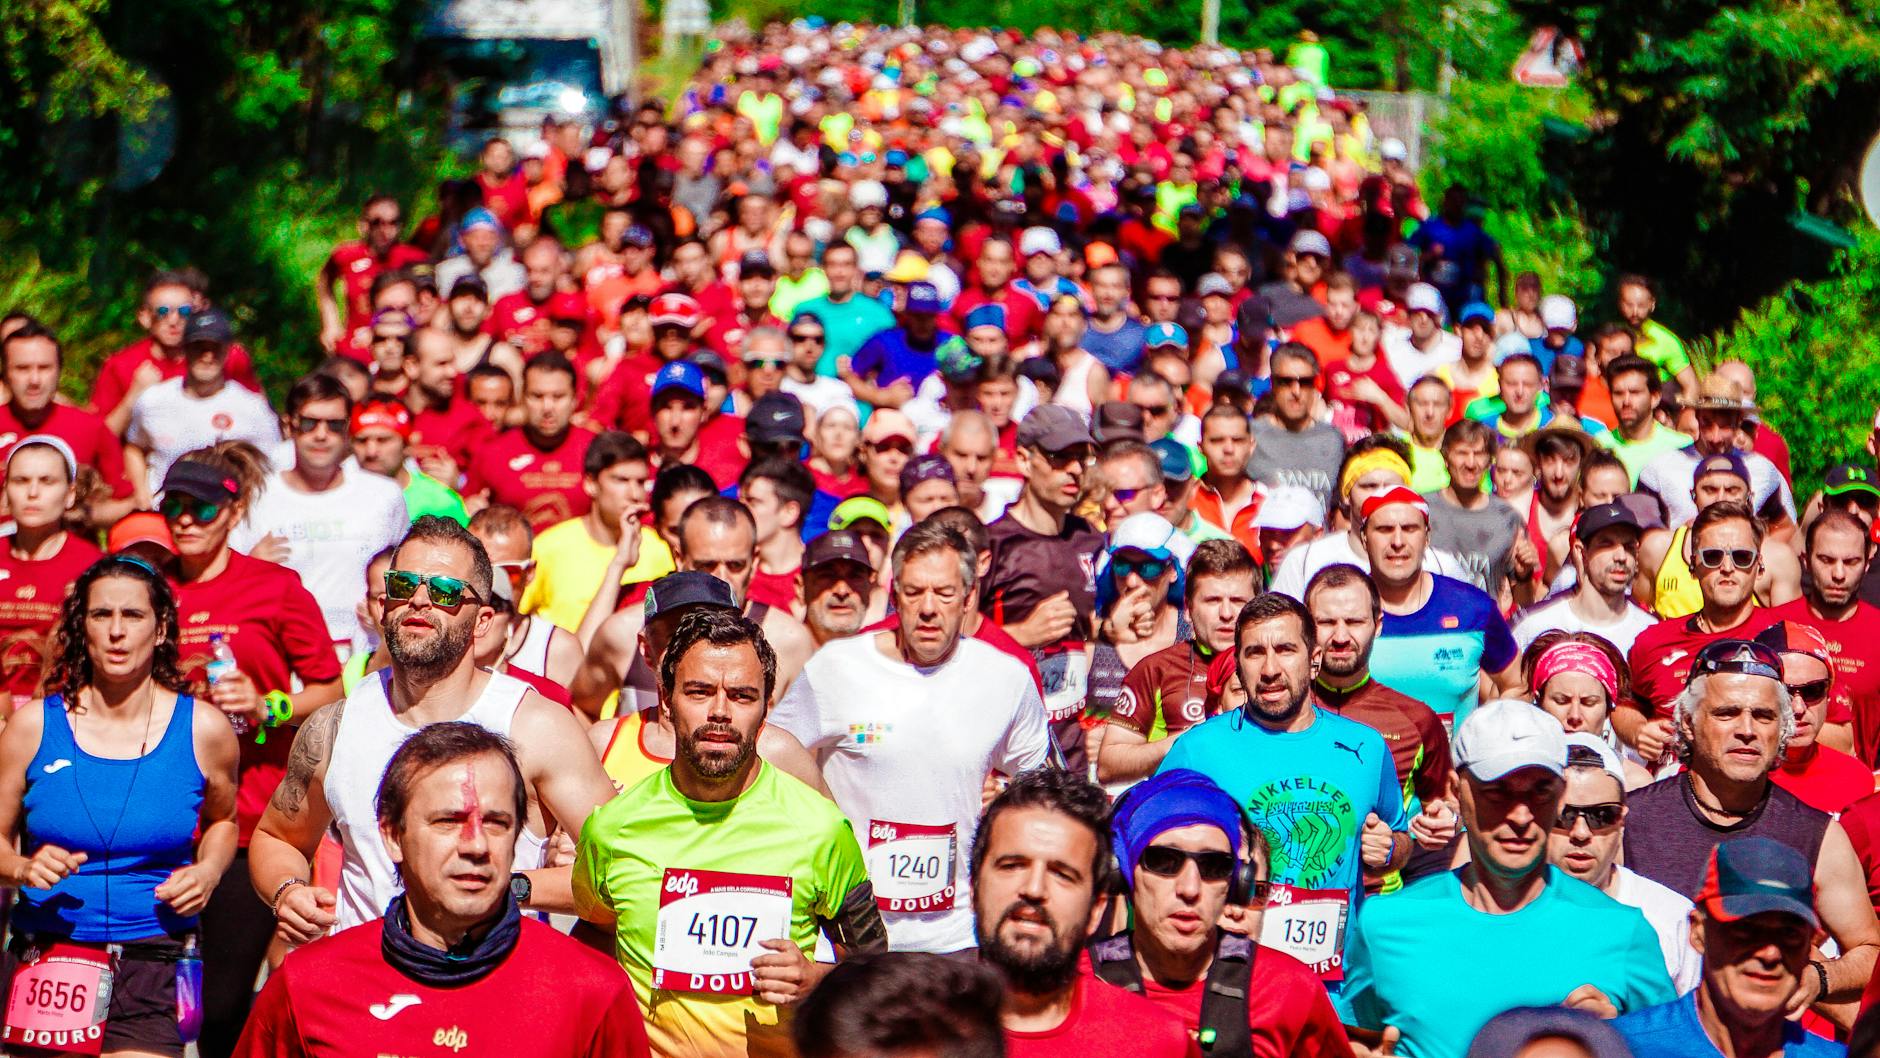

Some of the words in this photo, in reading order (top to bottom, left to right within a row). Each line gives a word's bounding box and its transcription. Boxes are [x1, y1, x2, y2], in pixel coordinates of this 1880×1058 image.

[1248, 778, 1352, 815] MIKKELLER
[871, 824, 897, 844] edp
[889, 854, 940, 879] 1240
[1305, 854, 1345, 889] MILE
[666, 873, 698, 898] edp
[890, 886, 955, 911] DOURO
[687, 912, 758, 948] 4107
[1285, 918, 1327, 945] 1319
[26, 978, 87, 1013] 3656
[23, 1025, 101, 1046] DOURO
[432, 1025, 468, 1053] edp
